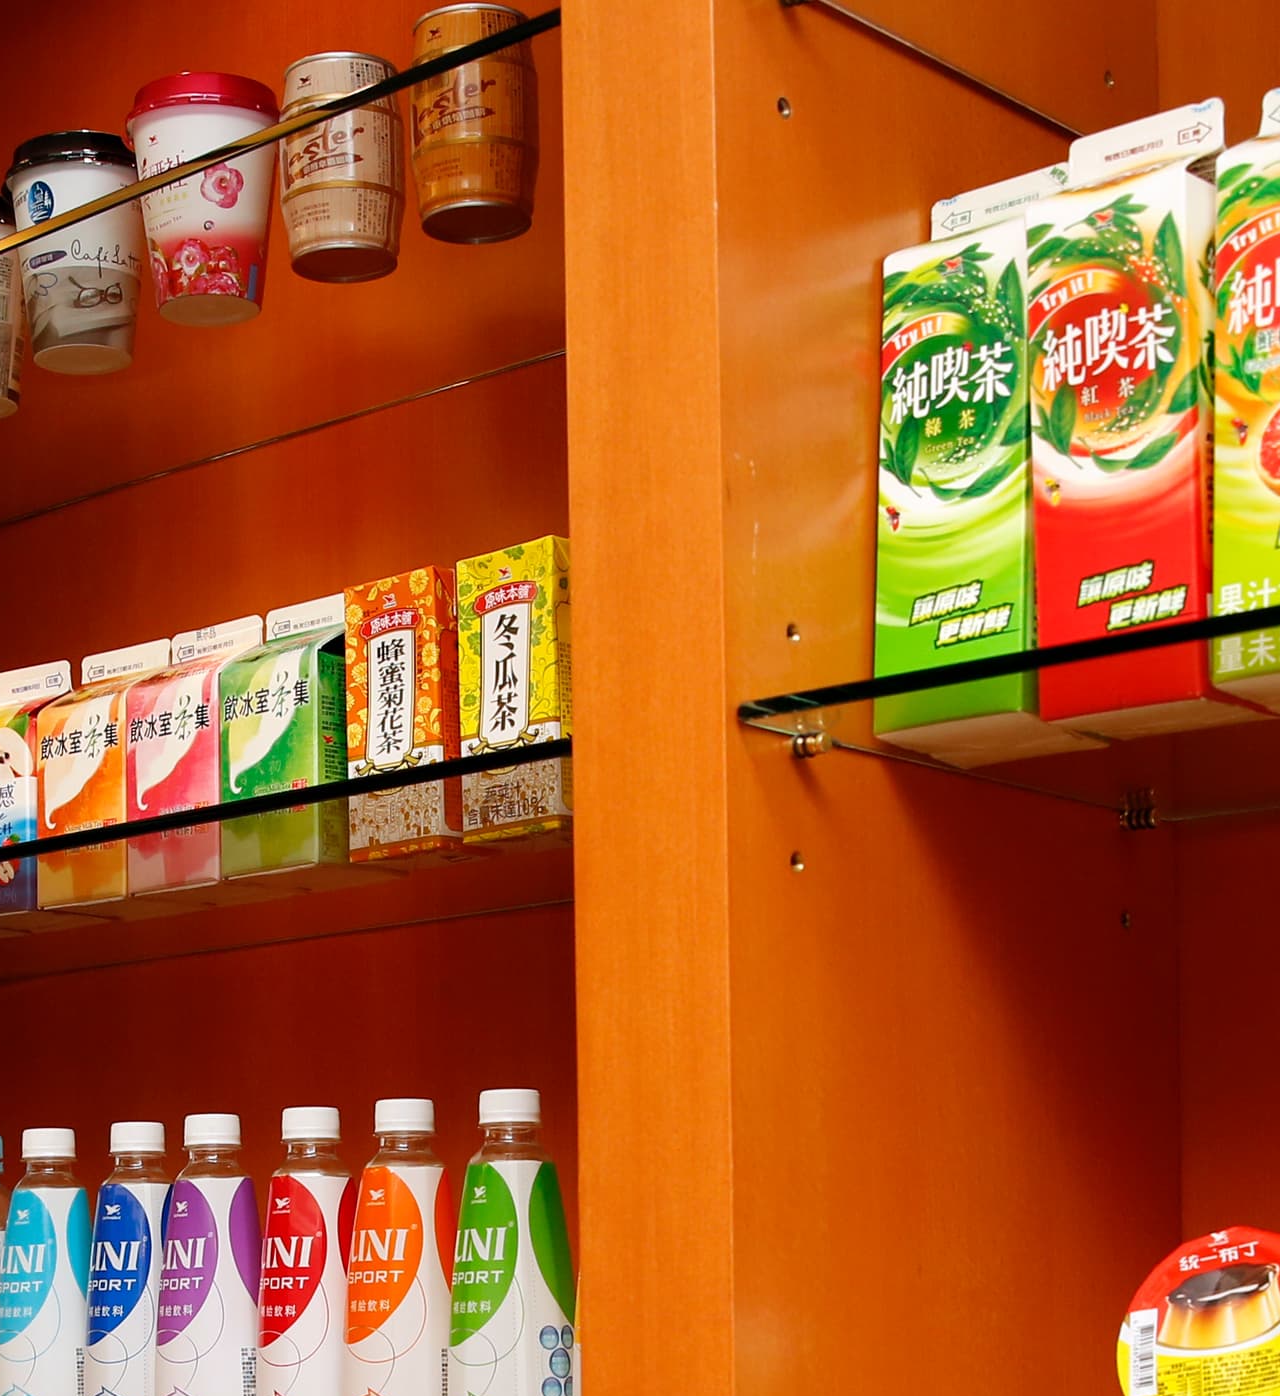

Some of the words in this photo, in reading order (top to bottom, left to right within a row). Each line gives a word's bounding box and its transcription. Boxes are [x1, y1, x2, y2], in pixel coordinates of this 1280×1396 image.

[1229, 228, 1258, 252] Try
[1038, 285, 1068, 311] Try
[1069, 271, 1093, 296] it!
[891, 329, 920, 351] Try
[920, 316, 943, 338] it!
[1042, 303, 1176, 391] 純喫茶
[889, 341, 1014, 425] 純喫茶
[1080, 377, 1136, 407] 紅茶
[924, 409, 976, 438] 綠茶
[484, 583, 532, 610] 原味本舖
[370, 610, 414, 635] 原味本舖
[489, 613, 521, 733] 冬瓜茶
[223, 670, 310, 722] 飲冰室茶集
[376, 638, 407, 756] 蜂蜜菊花茶
[39, 713, 119, 762] 飲冰室茶集
[129, 694, 211, 746] 飲冰室茶集
[1179, 1241, 1260, 1272] 統一布丁
[348, 1270, 405, 1285] SPORT
[451, 1270, 505, 1285] SPORT
